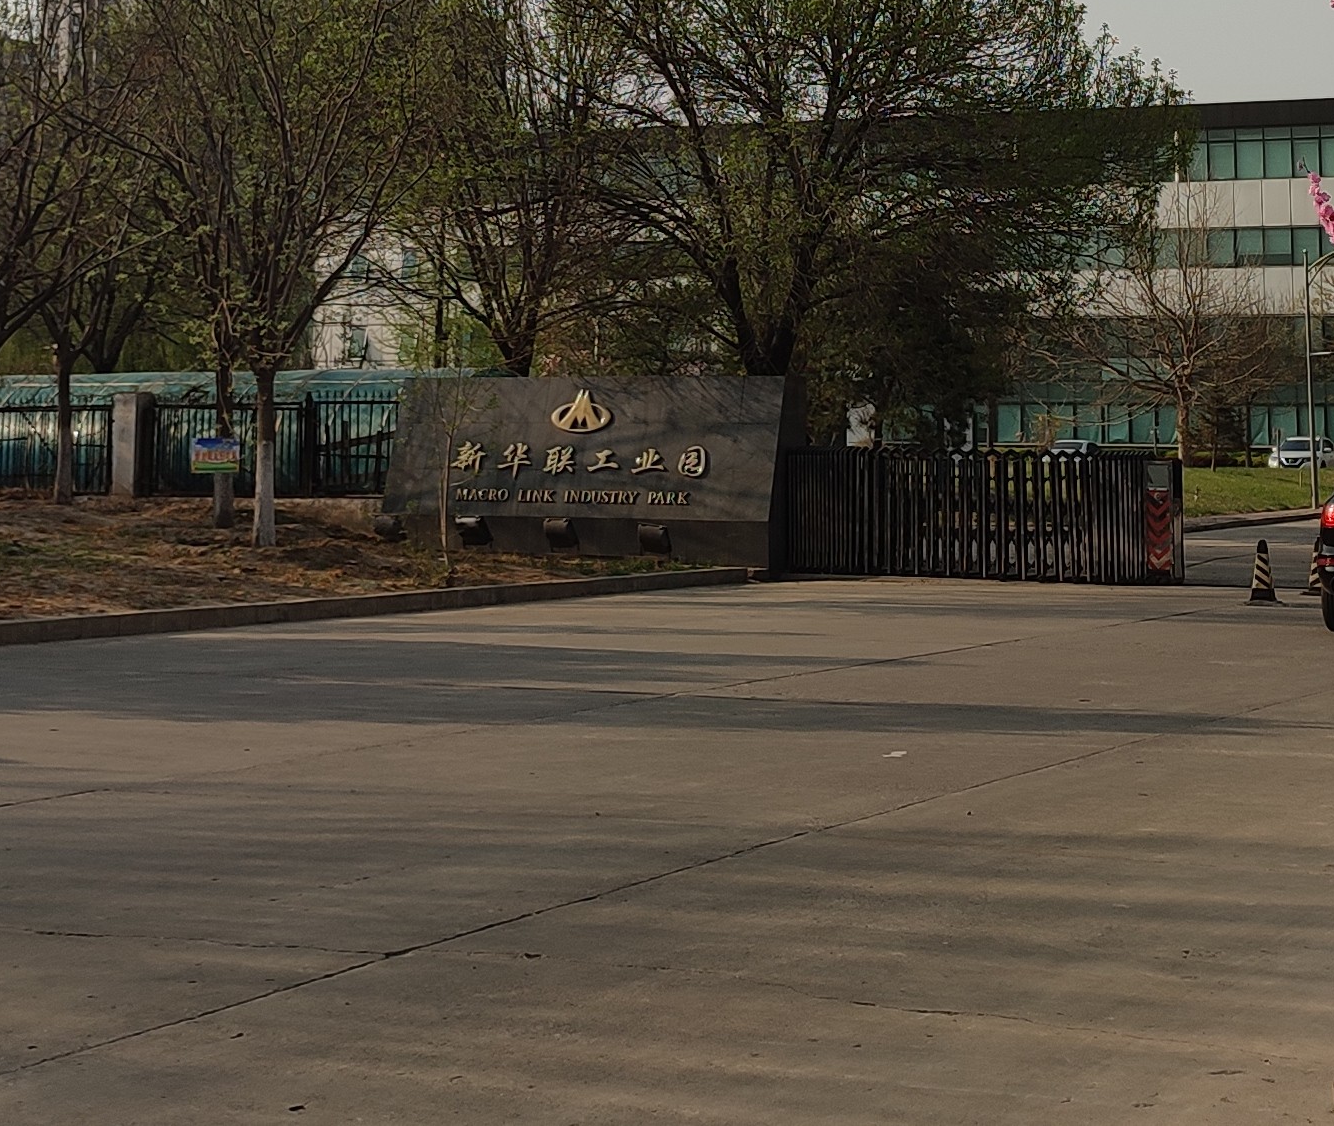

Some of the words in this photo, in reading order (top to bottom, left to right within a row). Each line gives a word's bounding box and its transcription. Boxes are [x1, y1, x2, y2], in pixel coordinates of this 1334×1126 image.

[450, 441, 706, 478] 新华联工业园
[455, 488, 508, 501] MACRO
[517, 489, 554, 502] LINK
[564, 490, 638, 504] INDUSTRY
[647, 491, 693, 505] PARK
